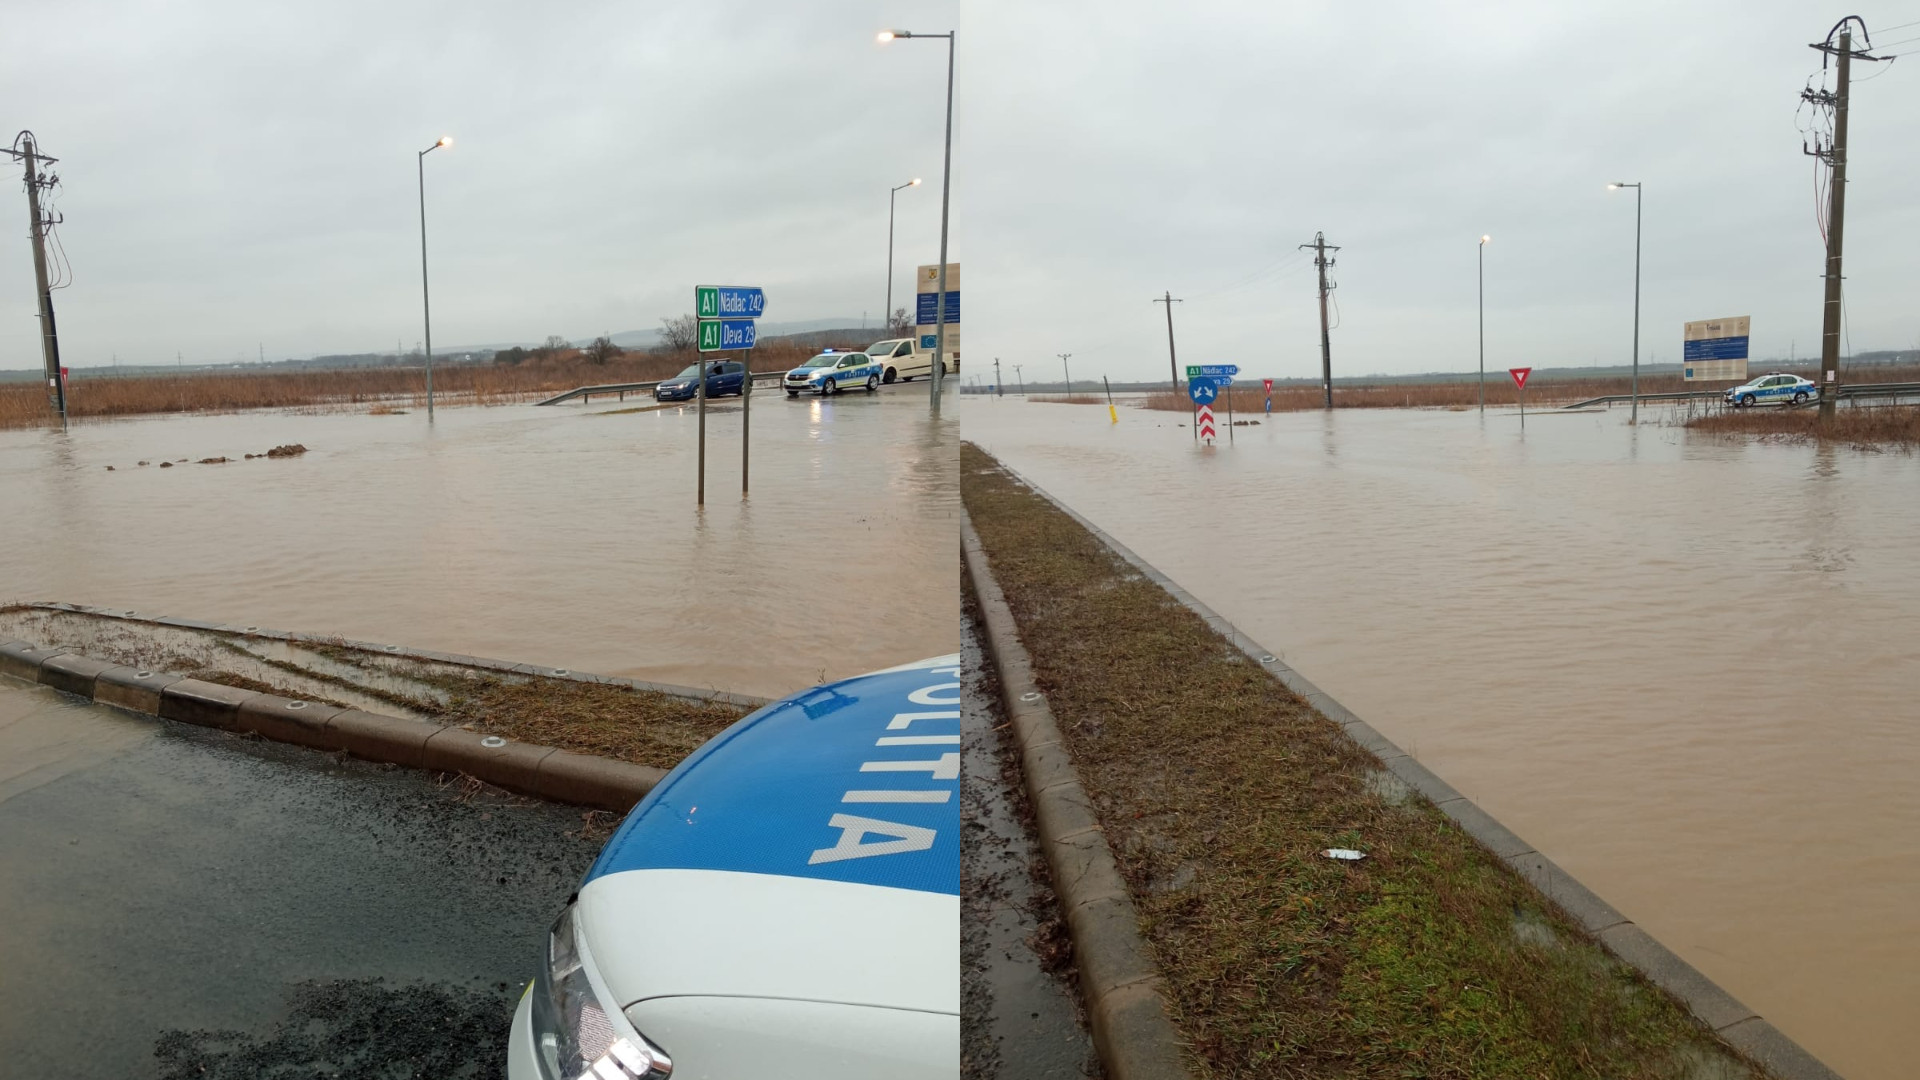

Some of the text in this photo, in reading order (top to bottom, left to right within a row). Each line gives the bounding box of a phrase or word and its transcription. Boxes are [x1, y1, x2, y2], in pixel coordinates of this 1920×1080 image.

[702, 292, 715, 313] A1
[748, 294, 762, 311] 242
[704, 324, 754, 346] A1 Deva 29
[1190, 367, 1200, 375] A1
[1224, 366, 1236, 374] 242
